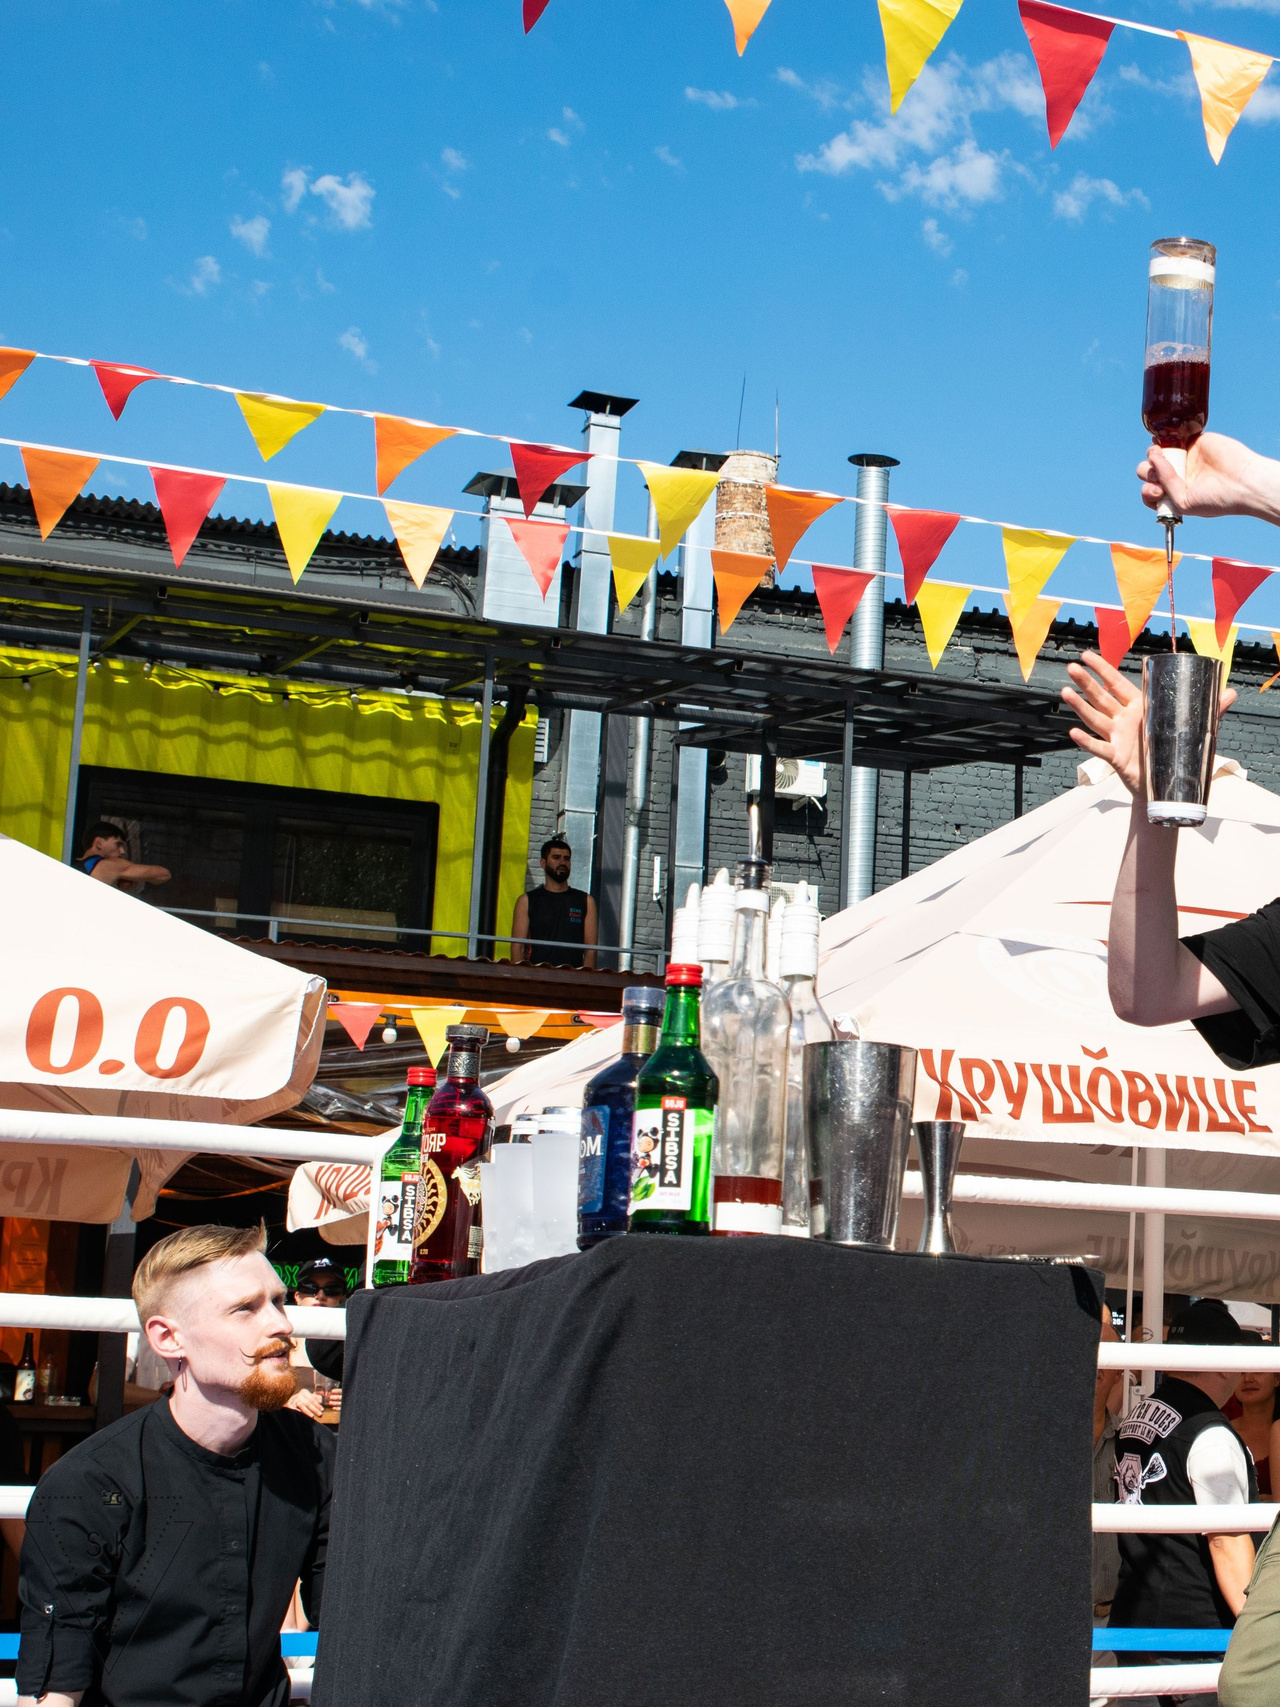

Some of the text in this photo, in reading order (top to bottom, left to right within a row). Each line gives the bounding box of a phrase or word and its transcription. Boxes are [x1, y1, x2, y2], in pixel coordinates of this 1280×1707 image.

[26, 987, 210, 1079] 0.0
[665, 1099, 684, 1108] SOJU
[663, 1113, 680, 1184] SIBSA
[401, 1185, 416, 1241] SIBSA
